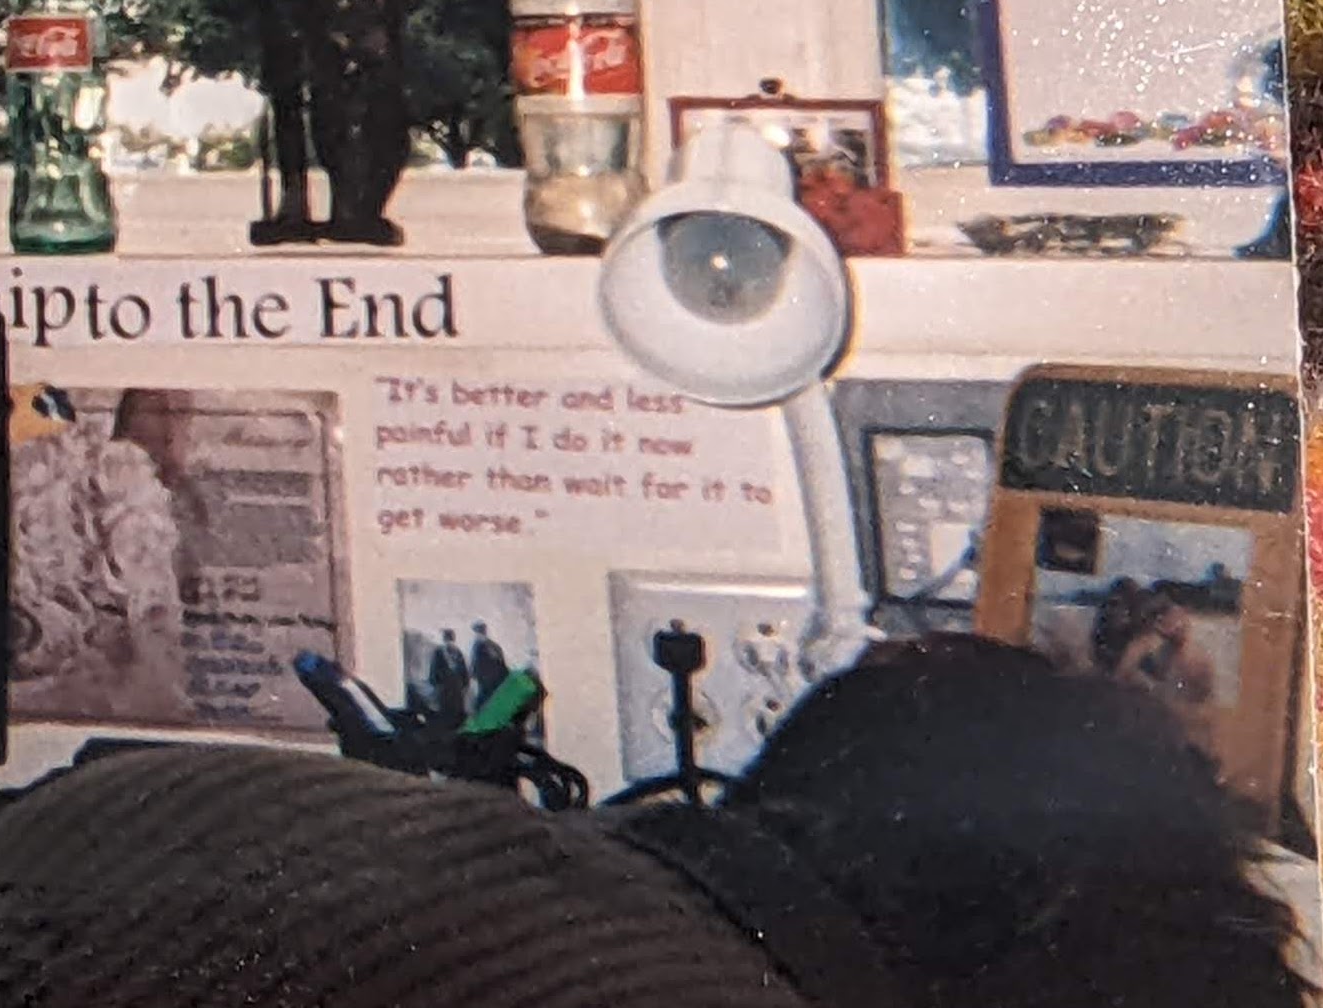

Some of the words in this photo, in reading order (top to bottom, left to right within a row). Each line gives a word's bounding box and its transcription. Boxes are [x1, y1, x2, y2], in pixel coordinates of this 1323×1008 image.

[85, 283, 151, 340] to
[177, 275, 290, 340] the
[316, 273, 459, 339] End
[452, 379, 548, 408] better
[561, 386, 614, 411] and
[627, 384, 683, 414] less
[377, 419, 472, 450] painful
[484, 421, 507, 450] if
[520, 424, 538, 450] I
[553, 427, 587, 452] do
[602, 428, 624, 451] it
[638, 437, 693, 454] now
[1018, 398, 1288, 496] CAUTION
[377, 464, 472, 488] rather
[487, 467, 552, 492] than
[563, 475, 627, 498] wait
[642, 472, 690, 499] for
[701, 479, 726, 500] it
[740, 481, 774, 504] to
[377, 509, 424, 535] get
